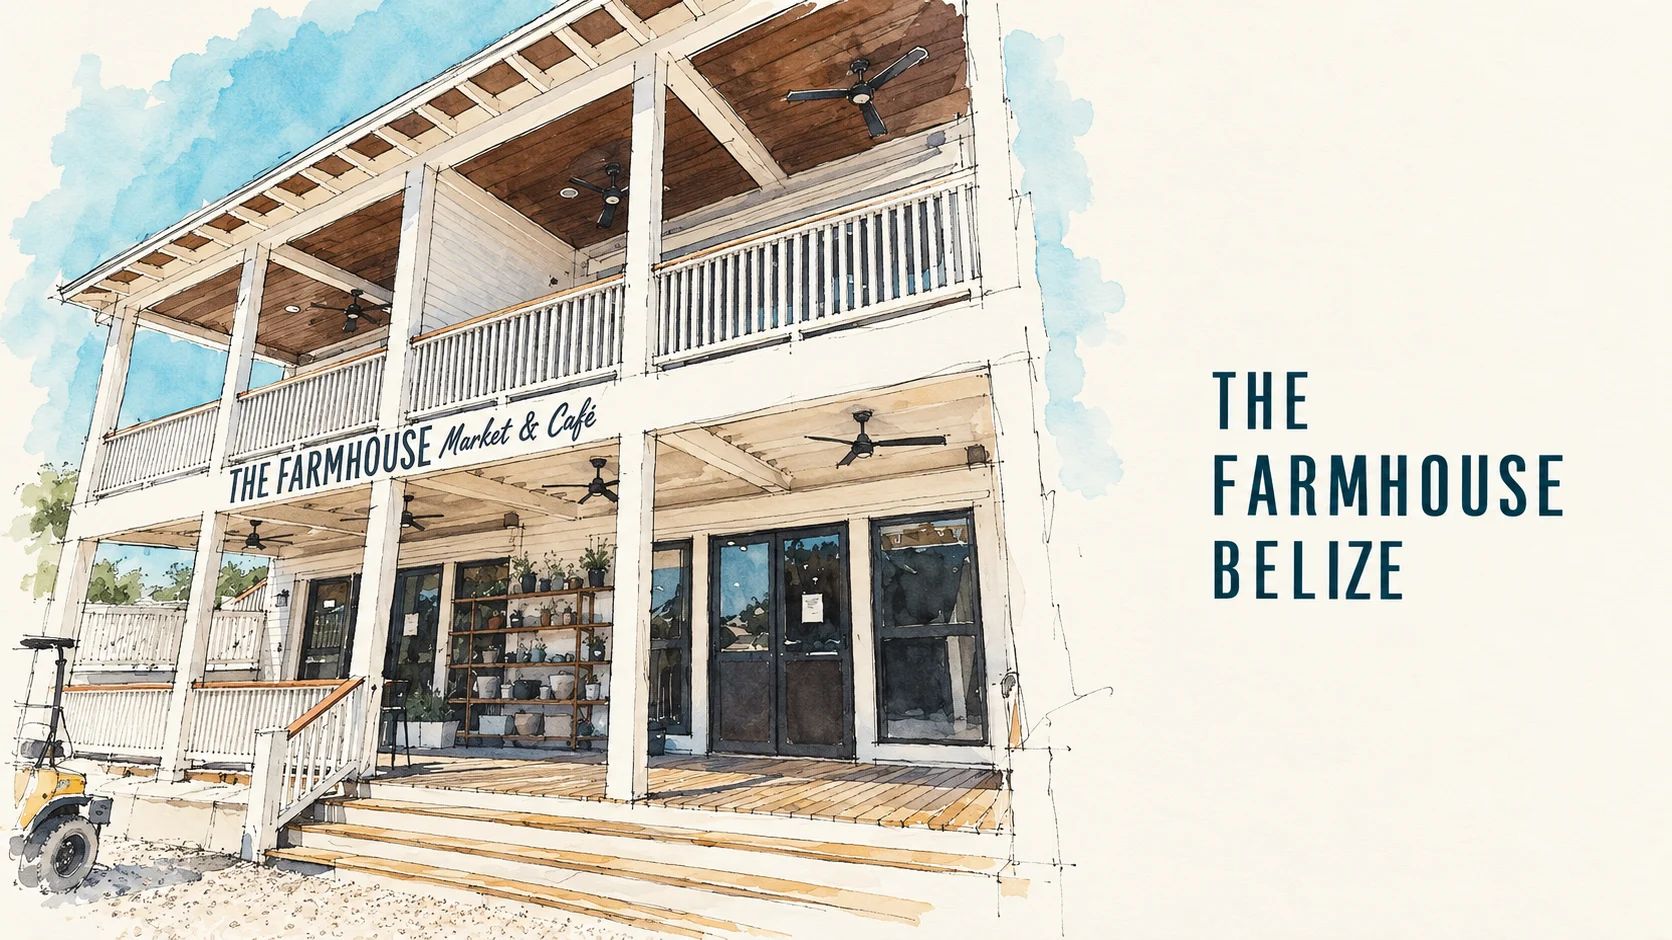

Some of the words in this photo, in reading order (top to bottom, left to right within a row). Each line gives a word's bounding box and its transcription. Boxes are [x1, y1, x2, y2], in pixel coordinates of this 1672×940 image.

[229, 461, 271, 503] THE
[276, 425, 433, 494] FARMHOUSE
[438, 417, 513, 458] Market
[518, 410, 540, 441] &
[547, 397, 597, 441] Café
